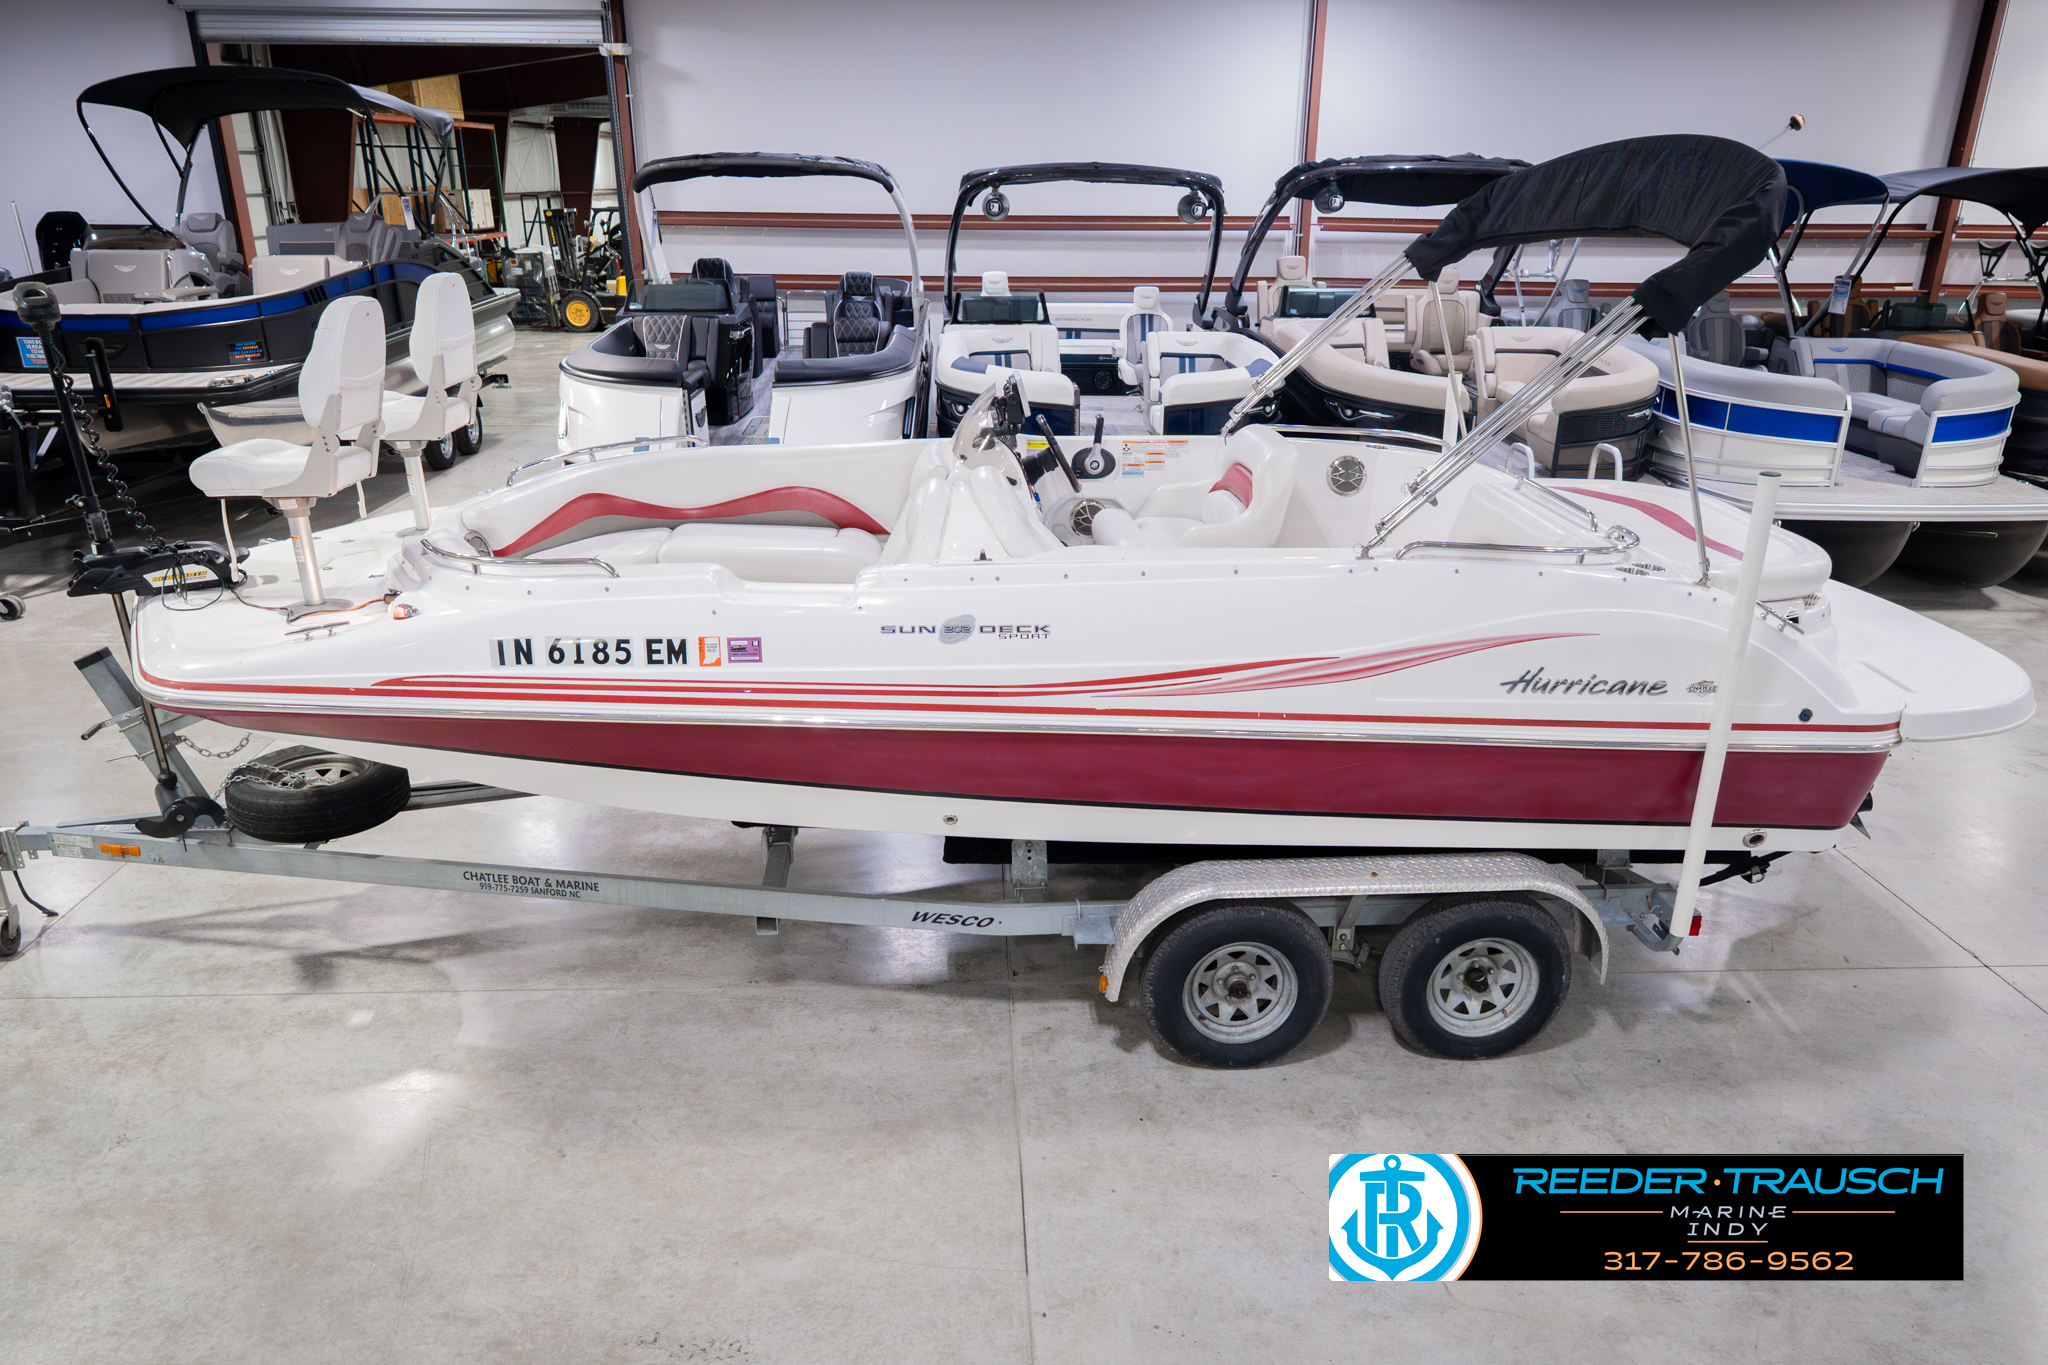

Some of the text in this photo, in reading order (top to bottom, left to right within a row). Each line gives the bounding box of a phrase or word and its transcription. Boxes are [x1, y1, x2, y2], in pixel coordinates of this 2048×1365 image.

[880, 625, 1051, 634] SUN 202 DECK
[496, 638, 688, 666] IN 6185 EM
[1500, 666, 1668, 696] Hurricane
[463, 871, 600, 892] CHATLEE BOAT & MARINE
[479, 882, 581, 899] 919-775-7259 SANFORD NC
[912, 911, 995, 928] WESCO
